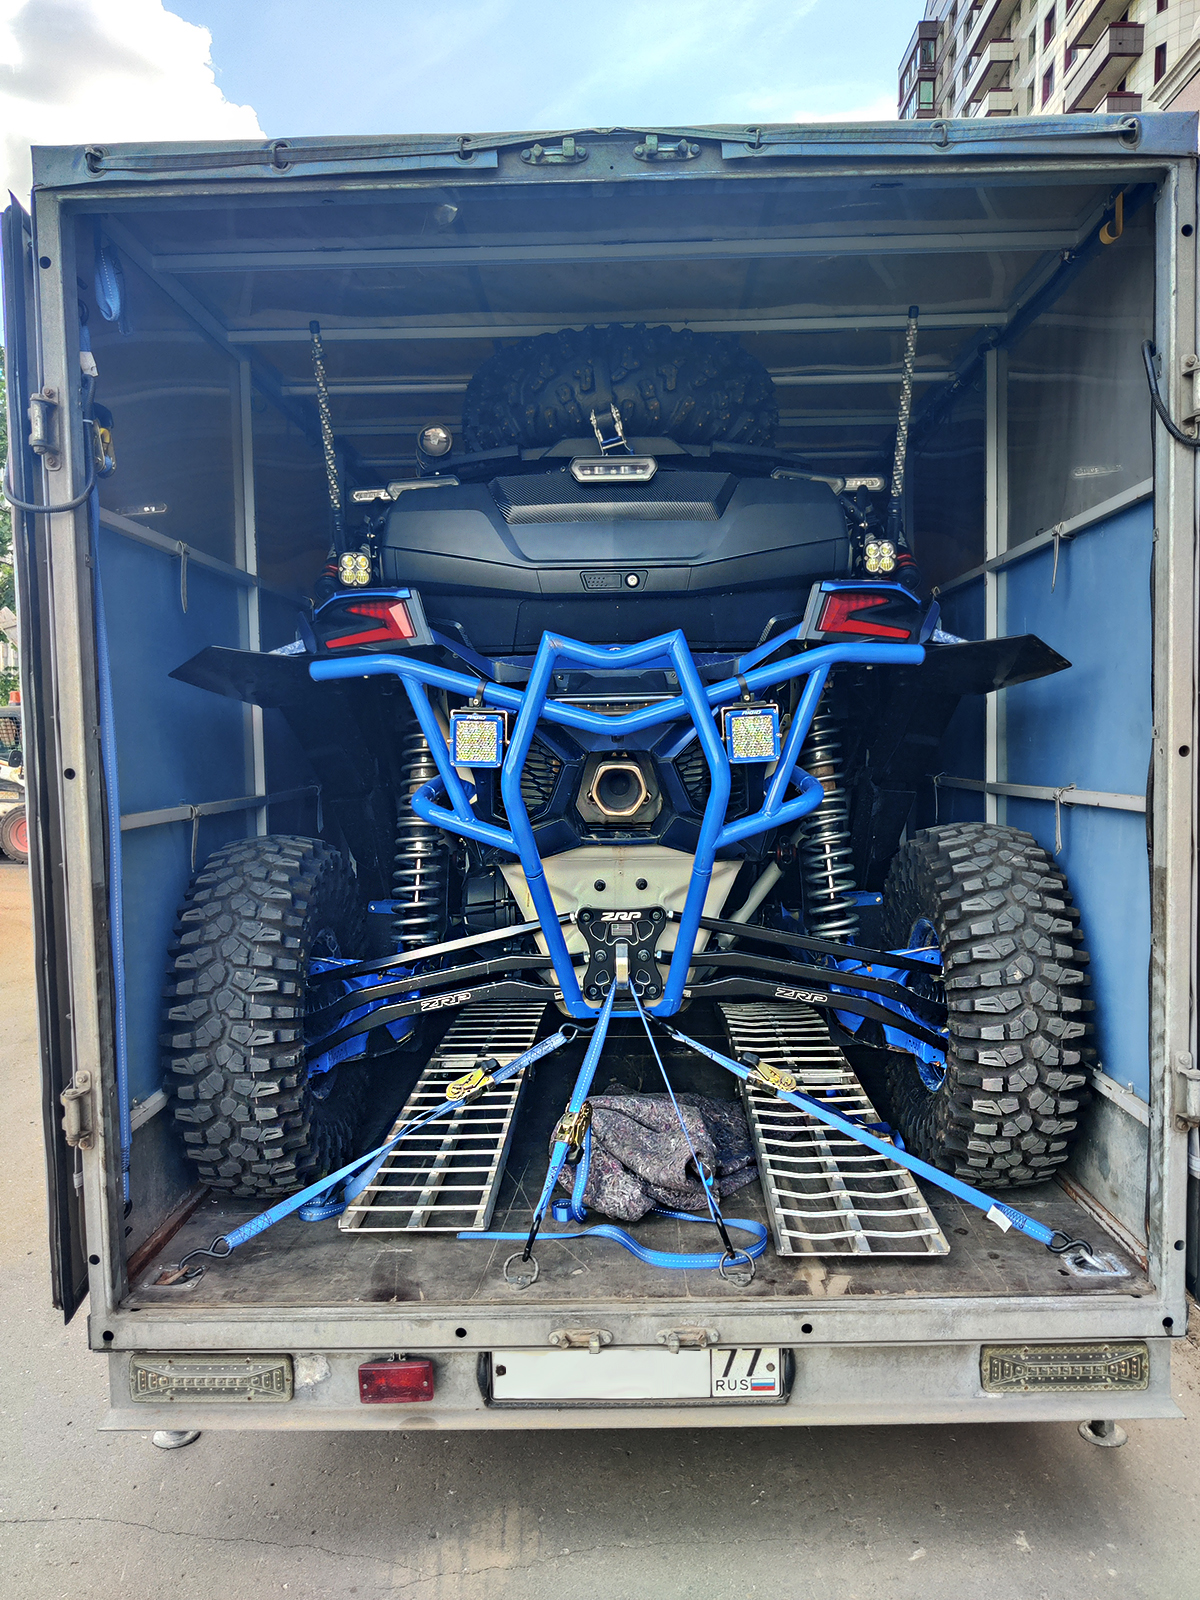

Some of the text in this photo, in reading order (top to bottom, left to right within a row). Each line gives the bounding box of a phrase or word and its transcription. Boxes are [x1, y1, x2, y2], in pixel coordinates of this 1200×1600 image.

[601, 911, 641, 921] ZRP
[420, 992, 471, 1011] ZRP
[775, 987, 828, 1003] ZRP
[717, 1348, 762, 1377] 77
[716, 1379, 749, 1391] RUS
